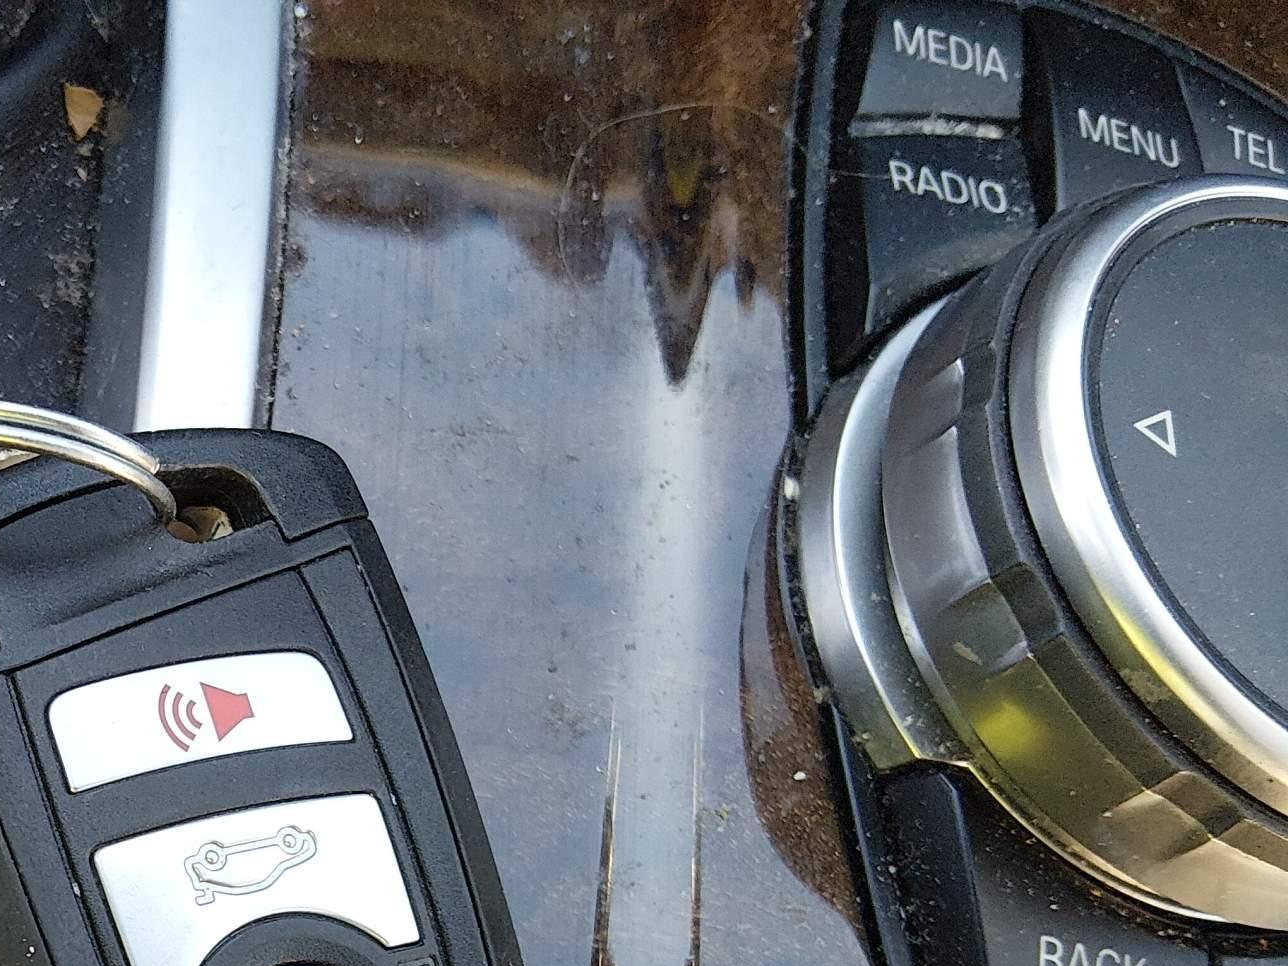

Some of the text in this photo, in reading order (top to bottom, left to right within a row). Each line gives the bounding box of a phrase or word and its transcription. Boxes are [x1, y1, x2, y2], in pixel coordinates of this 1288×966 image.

[892, 19, 1009, 83] MEDIA
[1077, 107, 1180, 169] MENU
[1226, 124, 1286, 175] TEL
[888, 159, 1008, 214] RADIO
